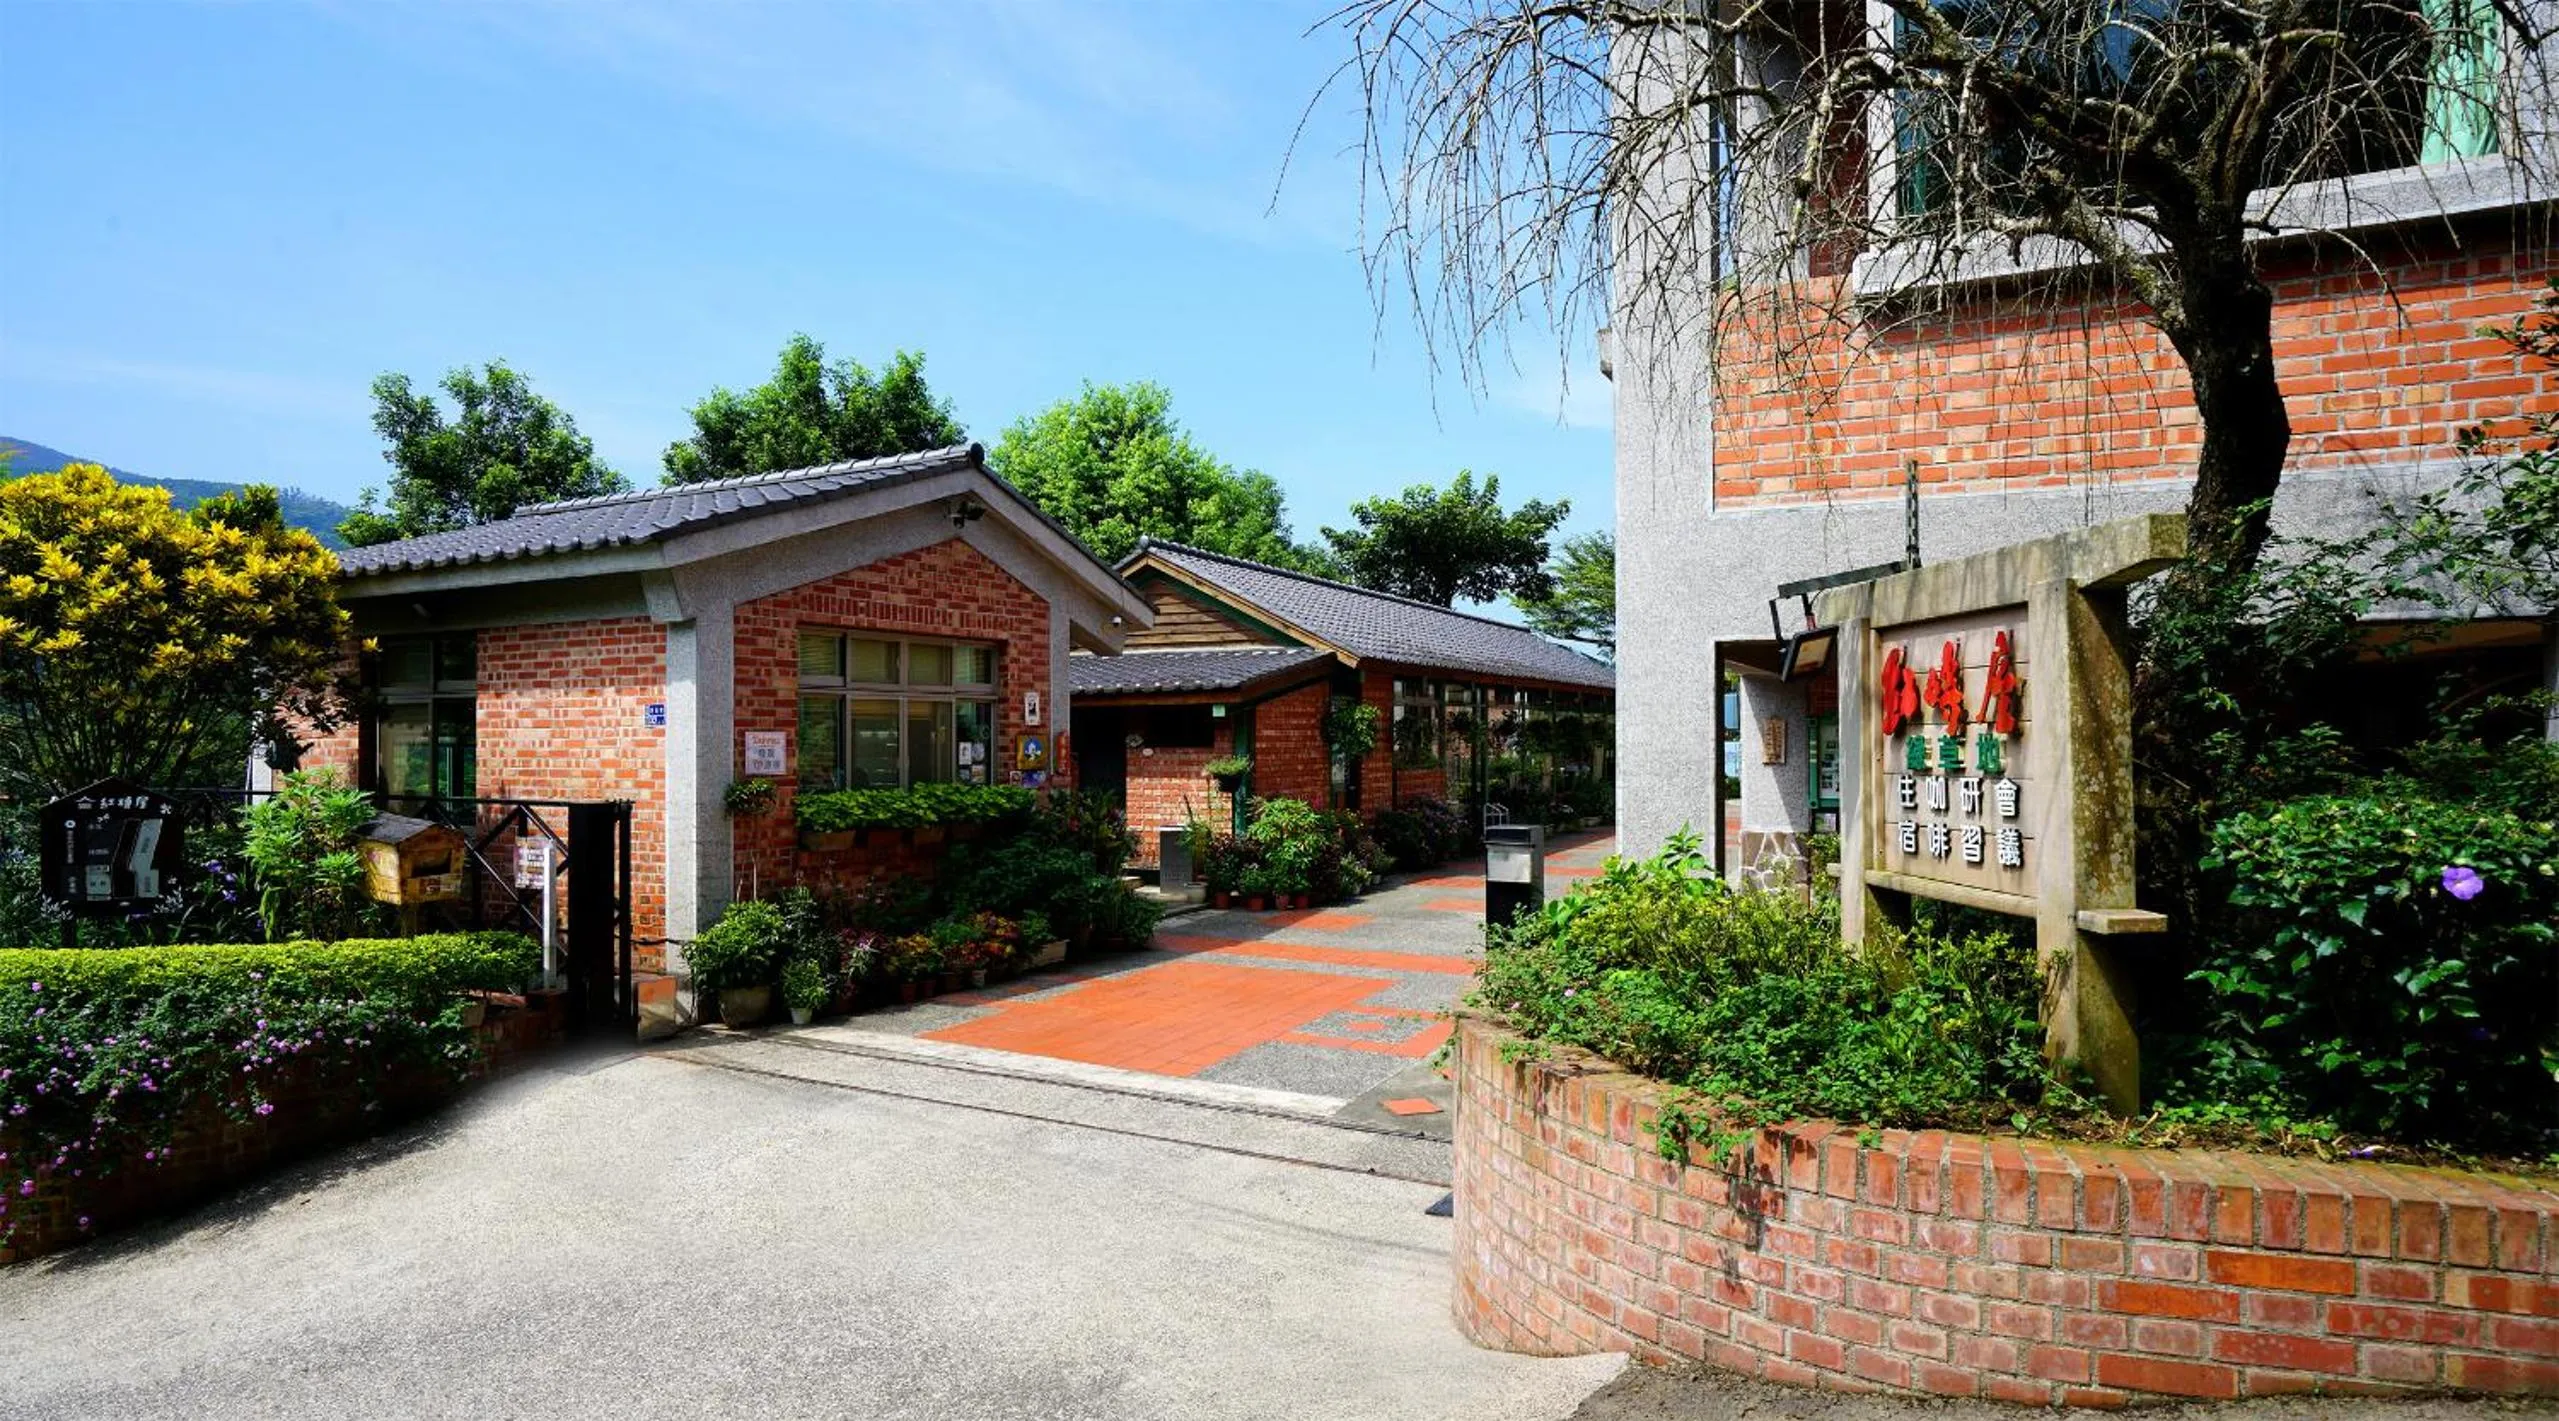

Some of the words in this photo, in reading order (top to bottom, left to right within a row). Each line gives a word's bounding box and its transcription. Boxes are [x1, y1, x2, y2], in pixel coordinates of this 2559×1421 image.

[1926, 776, 1950, 858] 咖啡
[1959, 777, 1981, 862] 研習
[1994, 778, 2021, 866] 會議
